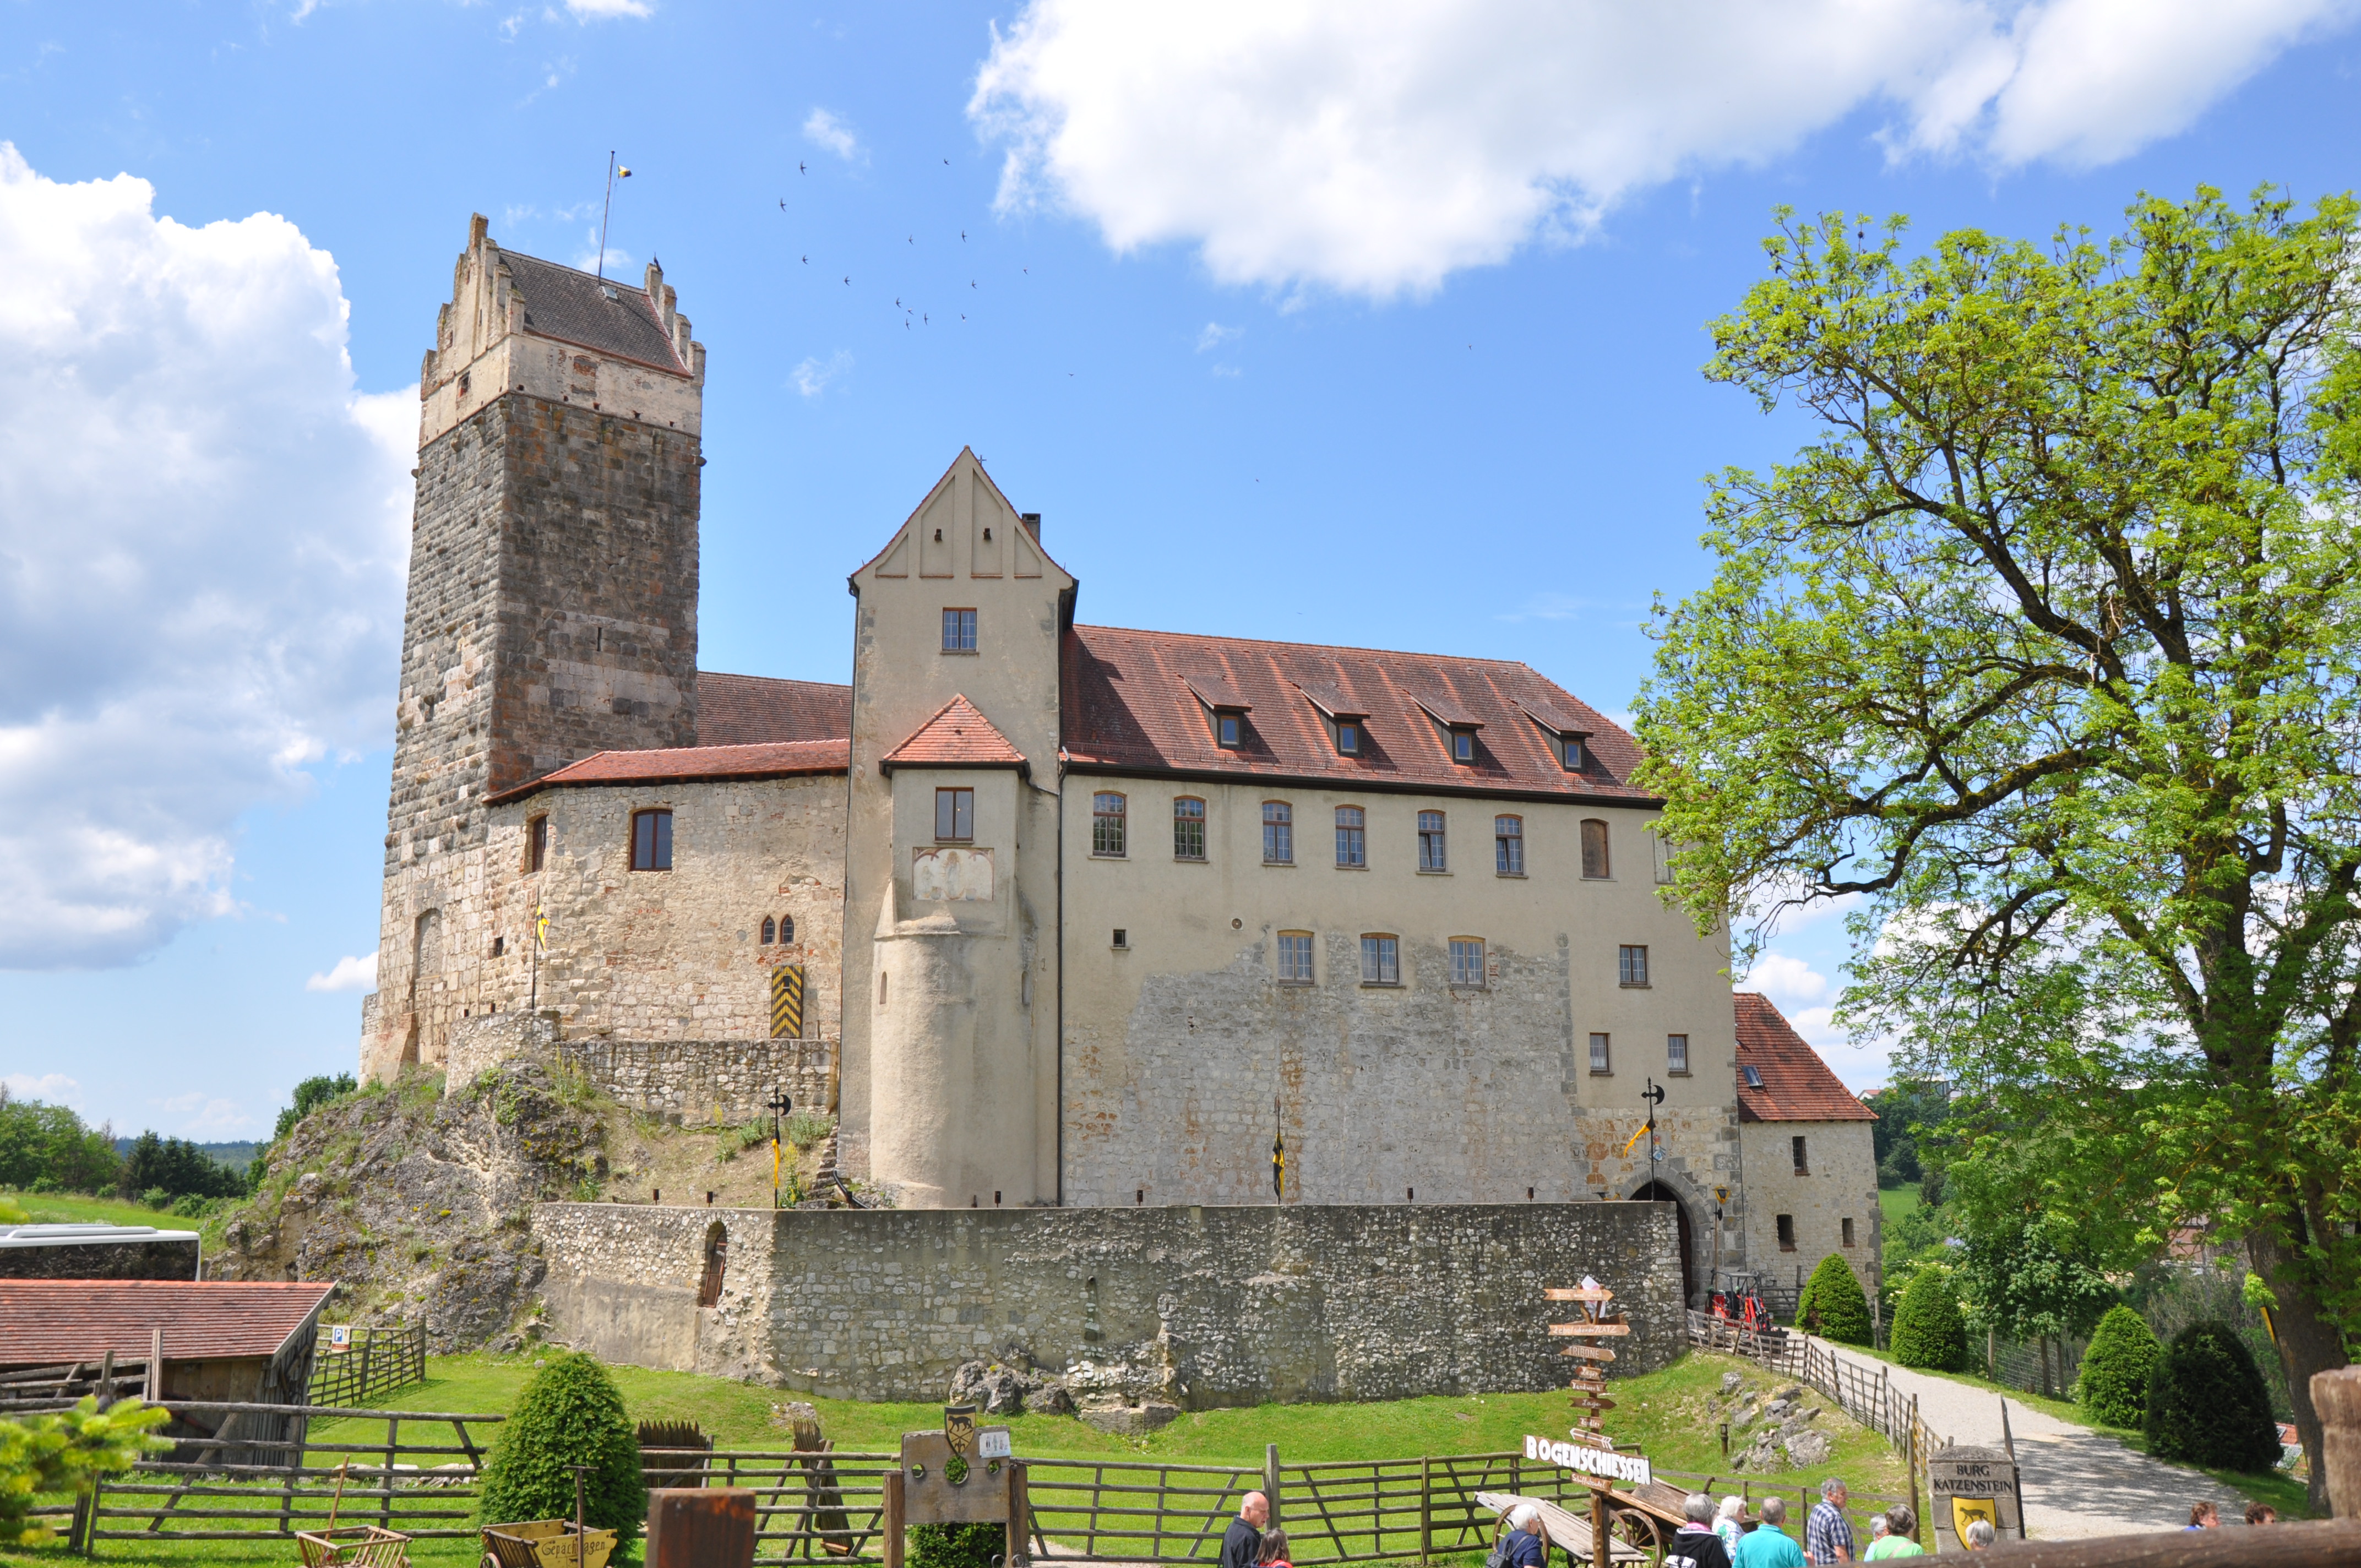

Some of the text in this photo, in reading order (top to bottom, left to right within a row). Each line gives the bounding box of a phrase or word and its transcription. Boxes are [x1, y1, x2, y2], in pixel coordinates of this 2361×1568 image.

[1526, 1435, 1651, 1485] BOGENSCHIESSEN
[1956, 1464, 1990, 1477] BURG
[1933, 1478, 2013, 1492] KATZENSTEIN
[541, 1540, 605, 1558] Gepäckagen
